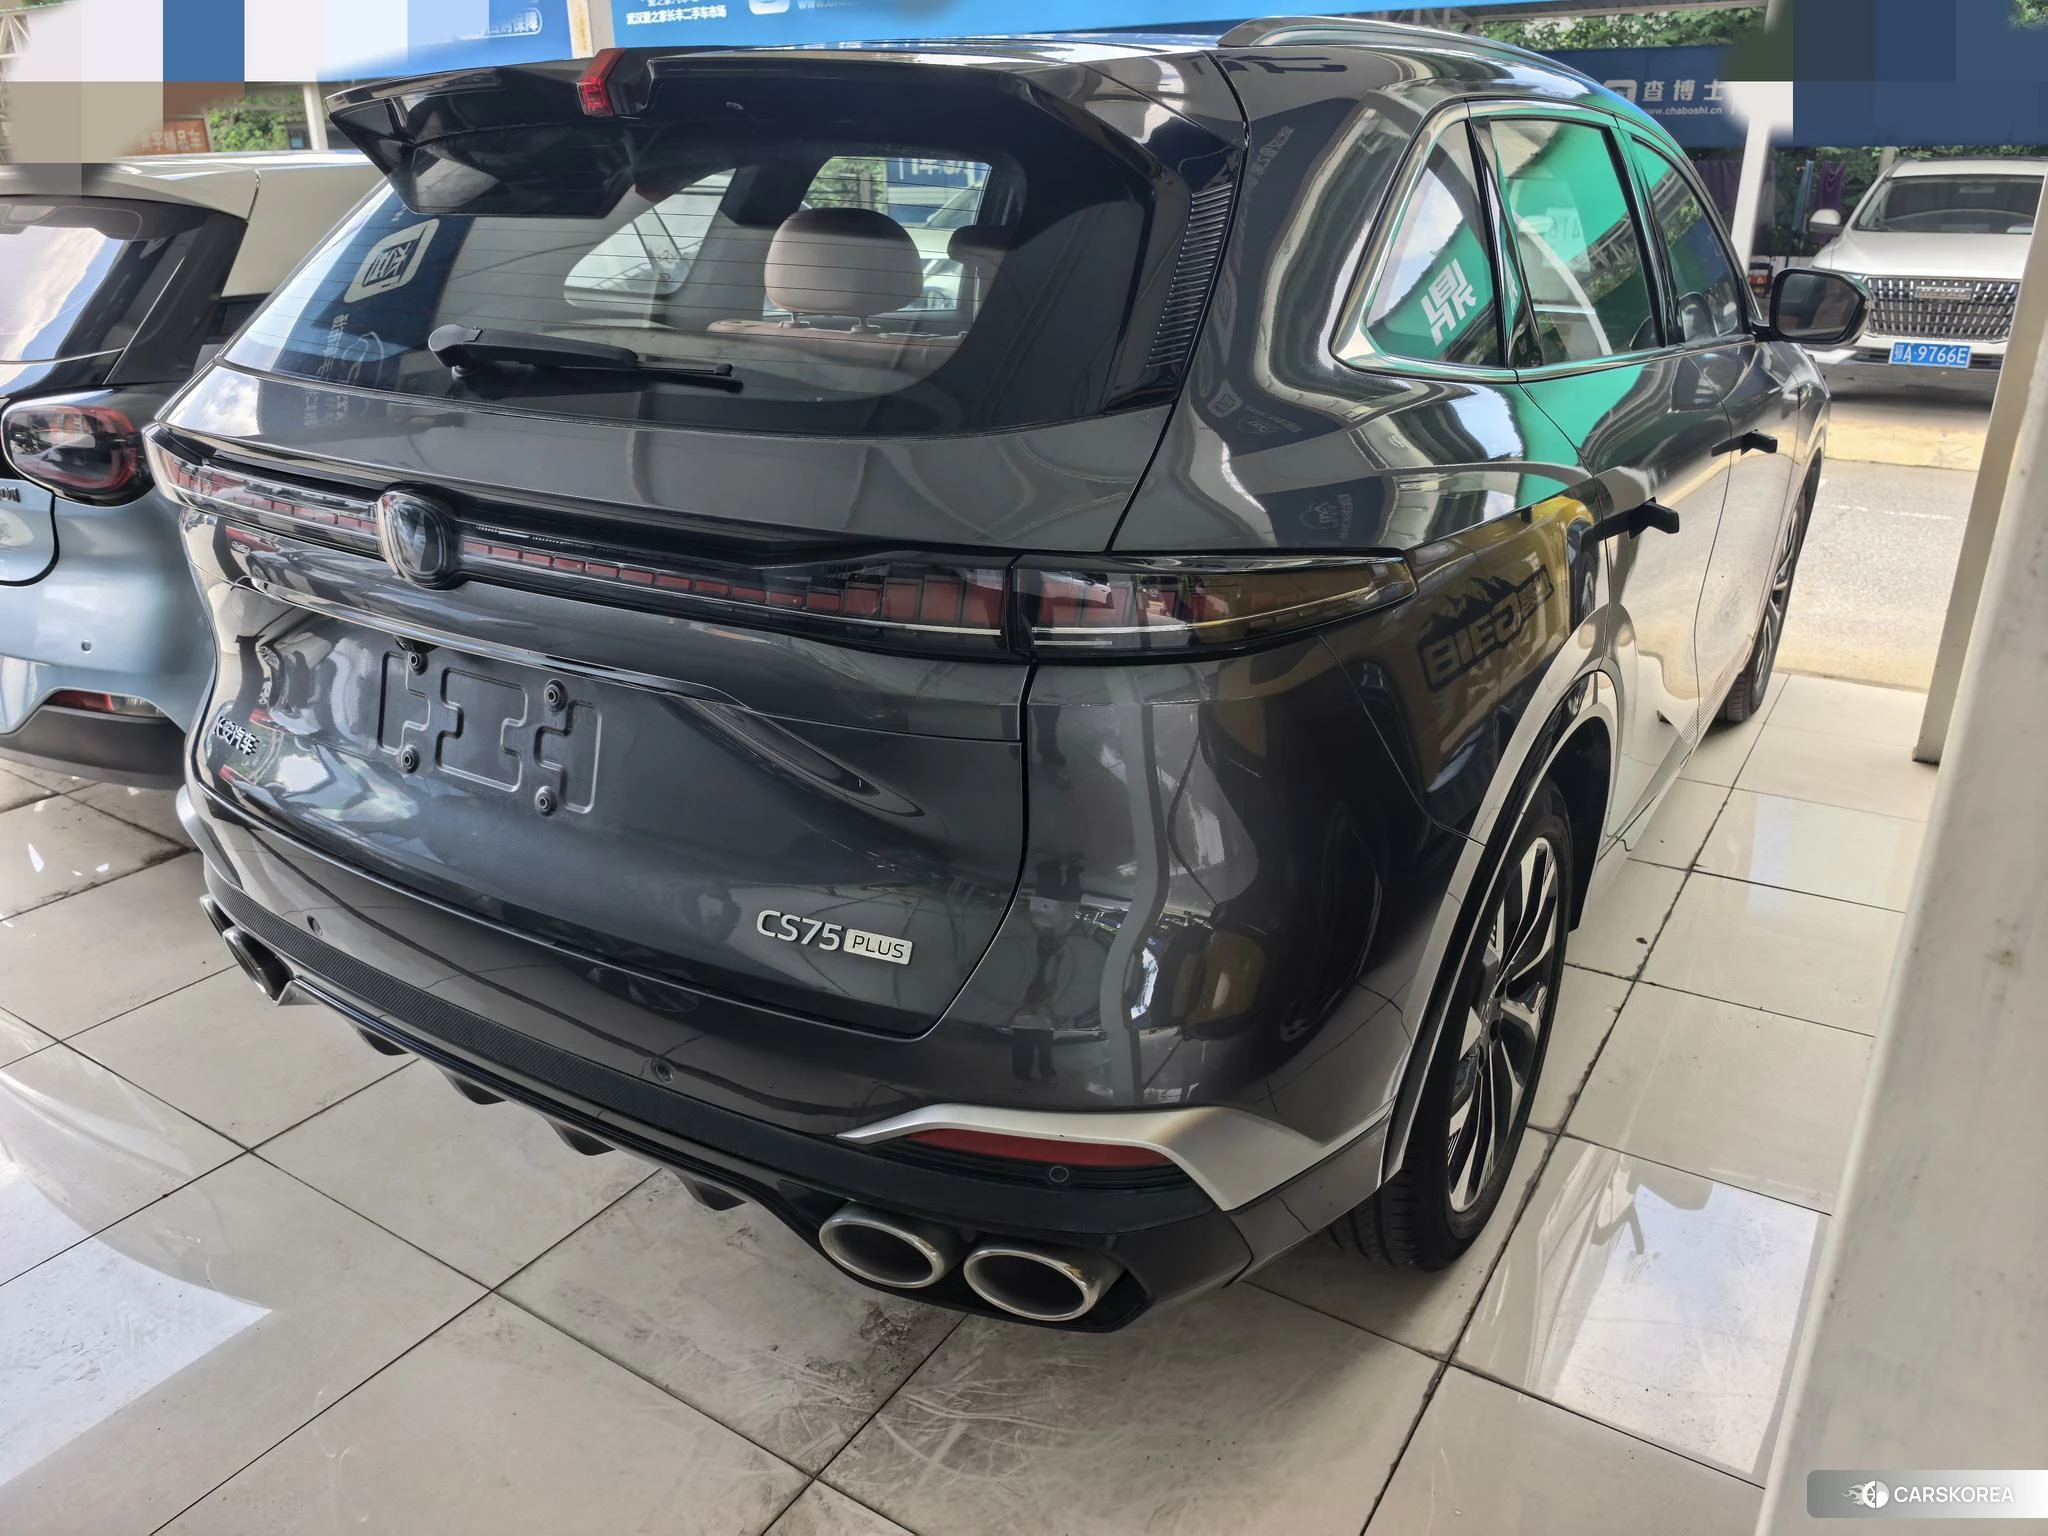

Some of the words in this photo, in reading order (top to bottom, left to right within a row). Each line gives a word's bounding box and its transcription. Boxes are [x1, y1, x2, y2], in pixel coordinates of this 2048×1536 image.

[1642, 79, 1725, 102] 查博士
[756, 909, 843, 951] CS75
[852, 934, 906, 960] PLUS
